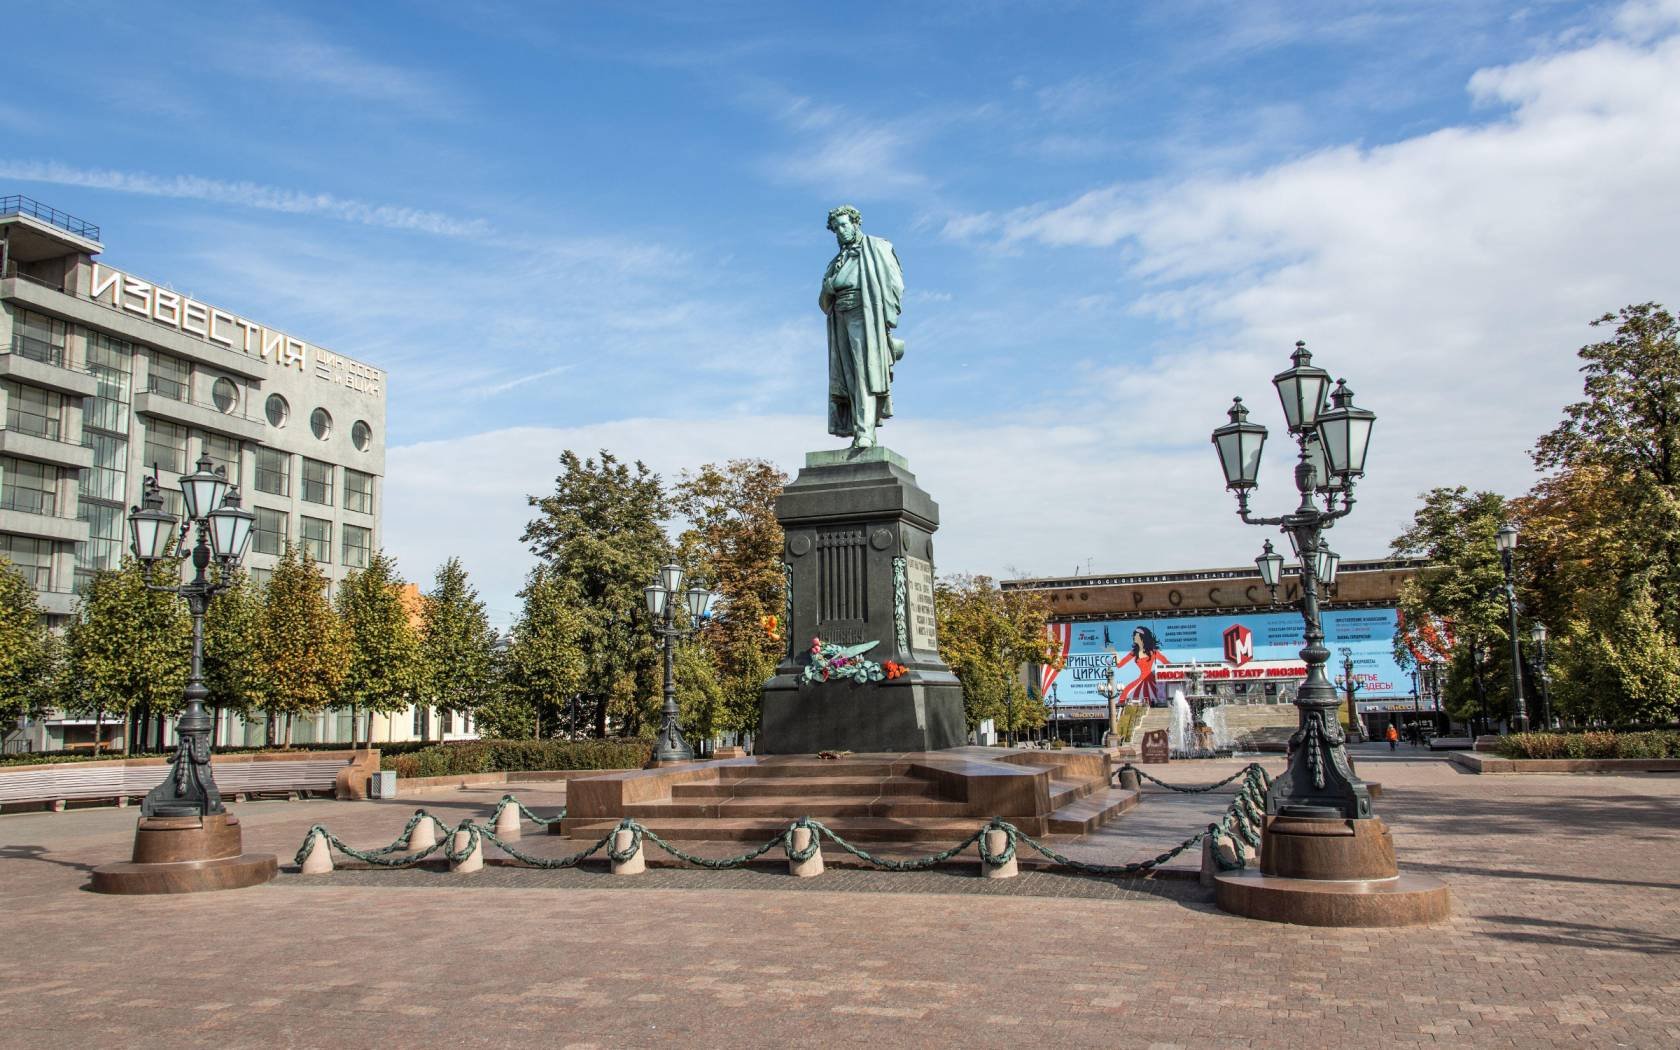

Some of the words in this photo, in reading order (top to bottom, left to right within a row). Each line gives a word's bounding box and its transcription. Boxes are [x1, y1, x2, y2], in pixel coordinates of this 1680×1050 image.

[91, 263, 305, 371] ИЗВЕСТИЯ
[1089, 575, 1167, 585] МОСКОВСКИЙ
[1195, 572, 1234, 580] ТЕАТР
[1072, 668, 1109, 680] ЦИРКА
[1232, 668, 1265, 678] ТЕАТР
